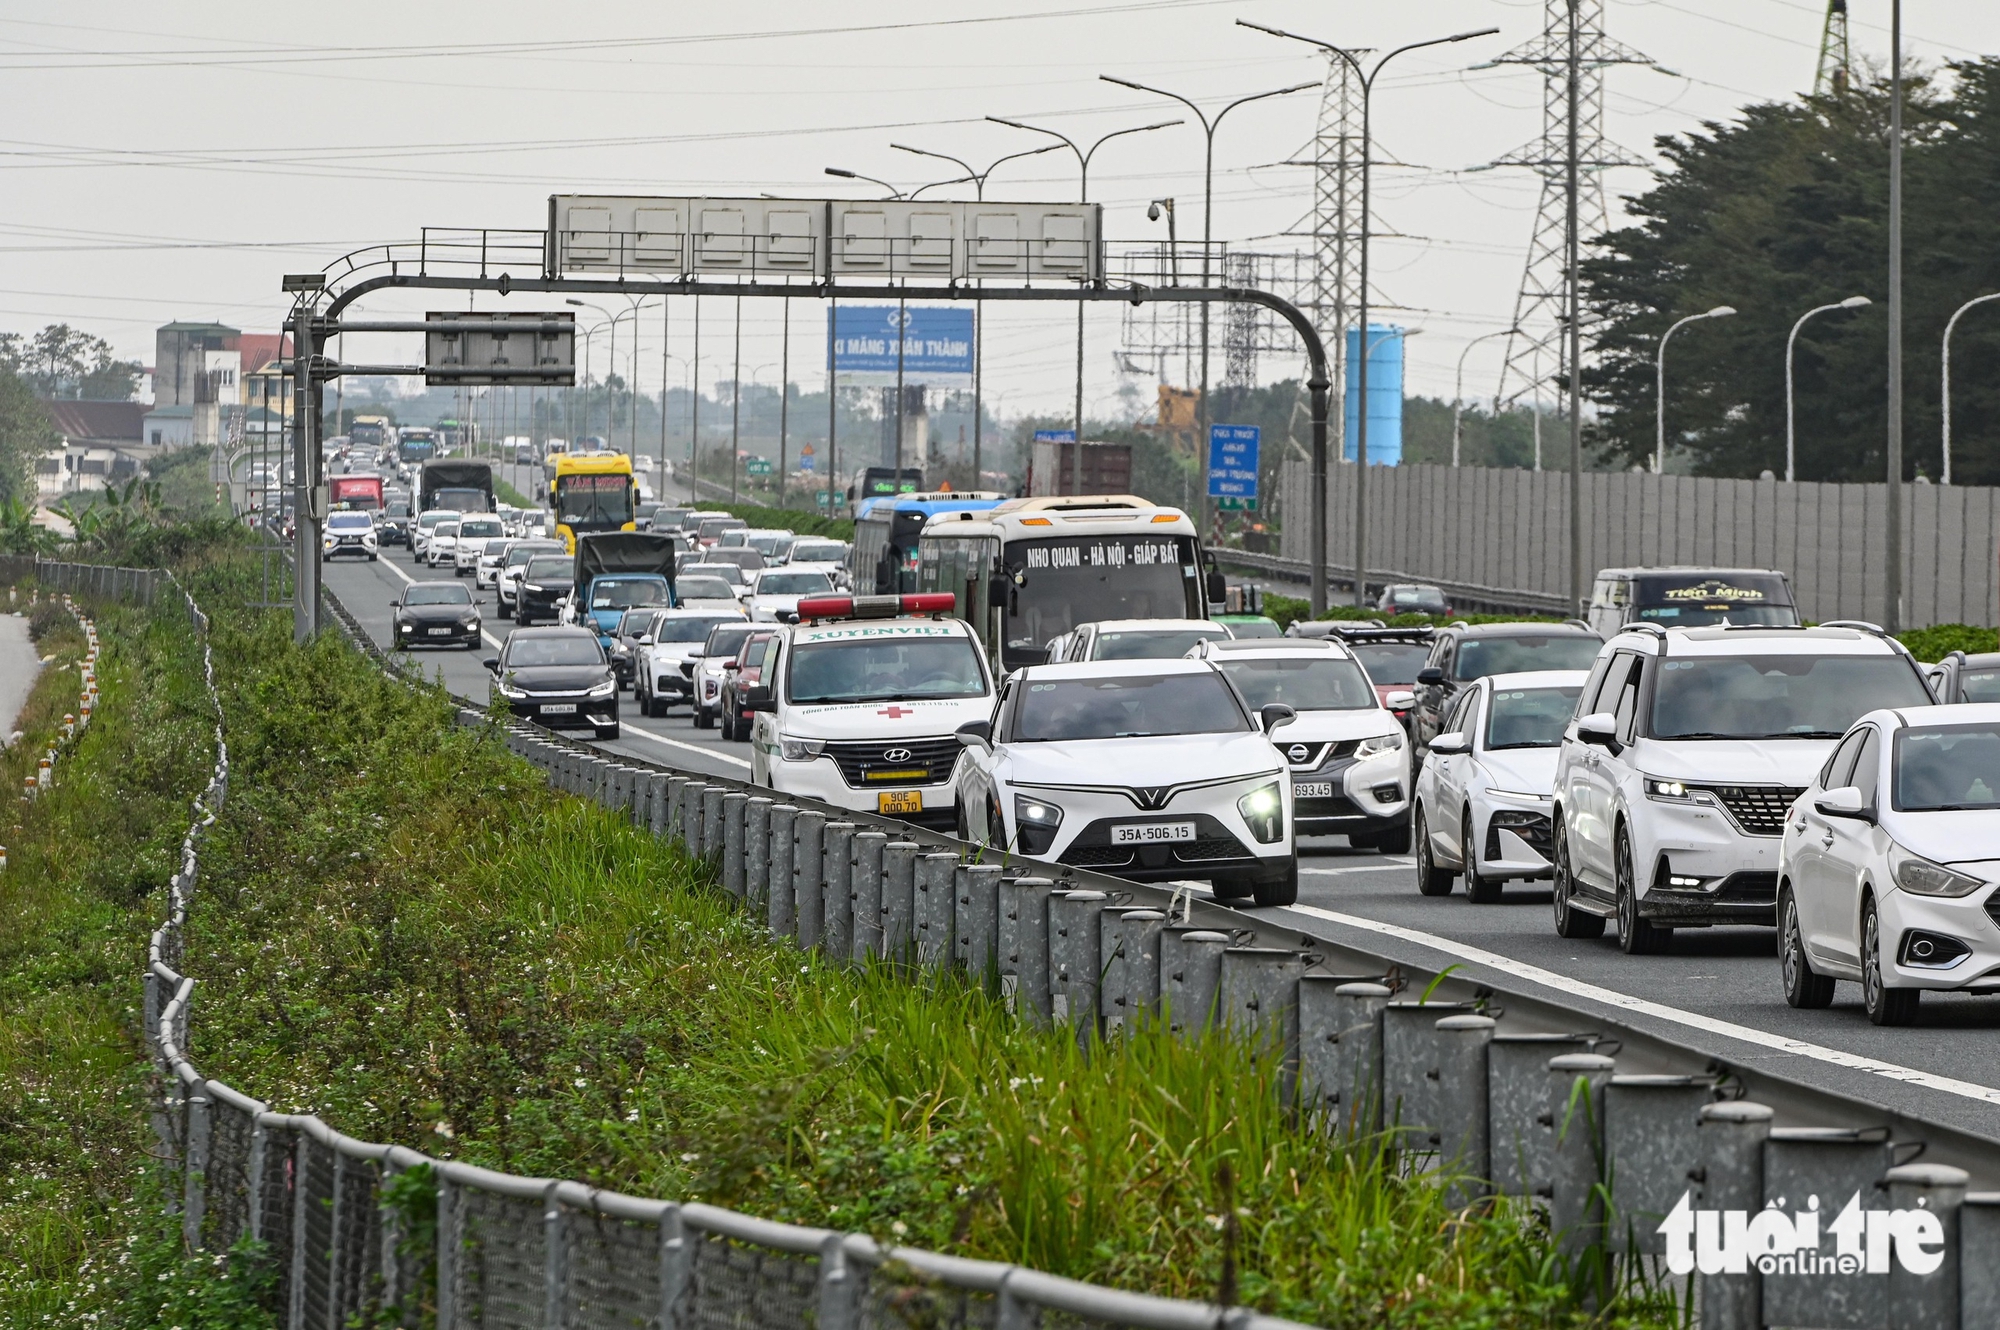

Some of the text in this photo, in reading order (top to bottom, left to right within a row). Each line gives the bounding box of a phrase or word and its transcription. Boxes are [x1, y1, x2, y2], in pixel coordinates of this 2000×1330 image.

[847, 335, 886, 355] MĂNG
[925, 336, 968, 358] THÀNH
[1027, 540, 1179, 569] NHO QUAN HÀ NỘI GIÁP BÁT
[1294, 784, 1331, 797] 693.45
[890, 792, 910, 803] 90E
[883, 802, 918, 813] 000.70
